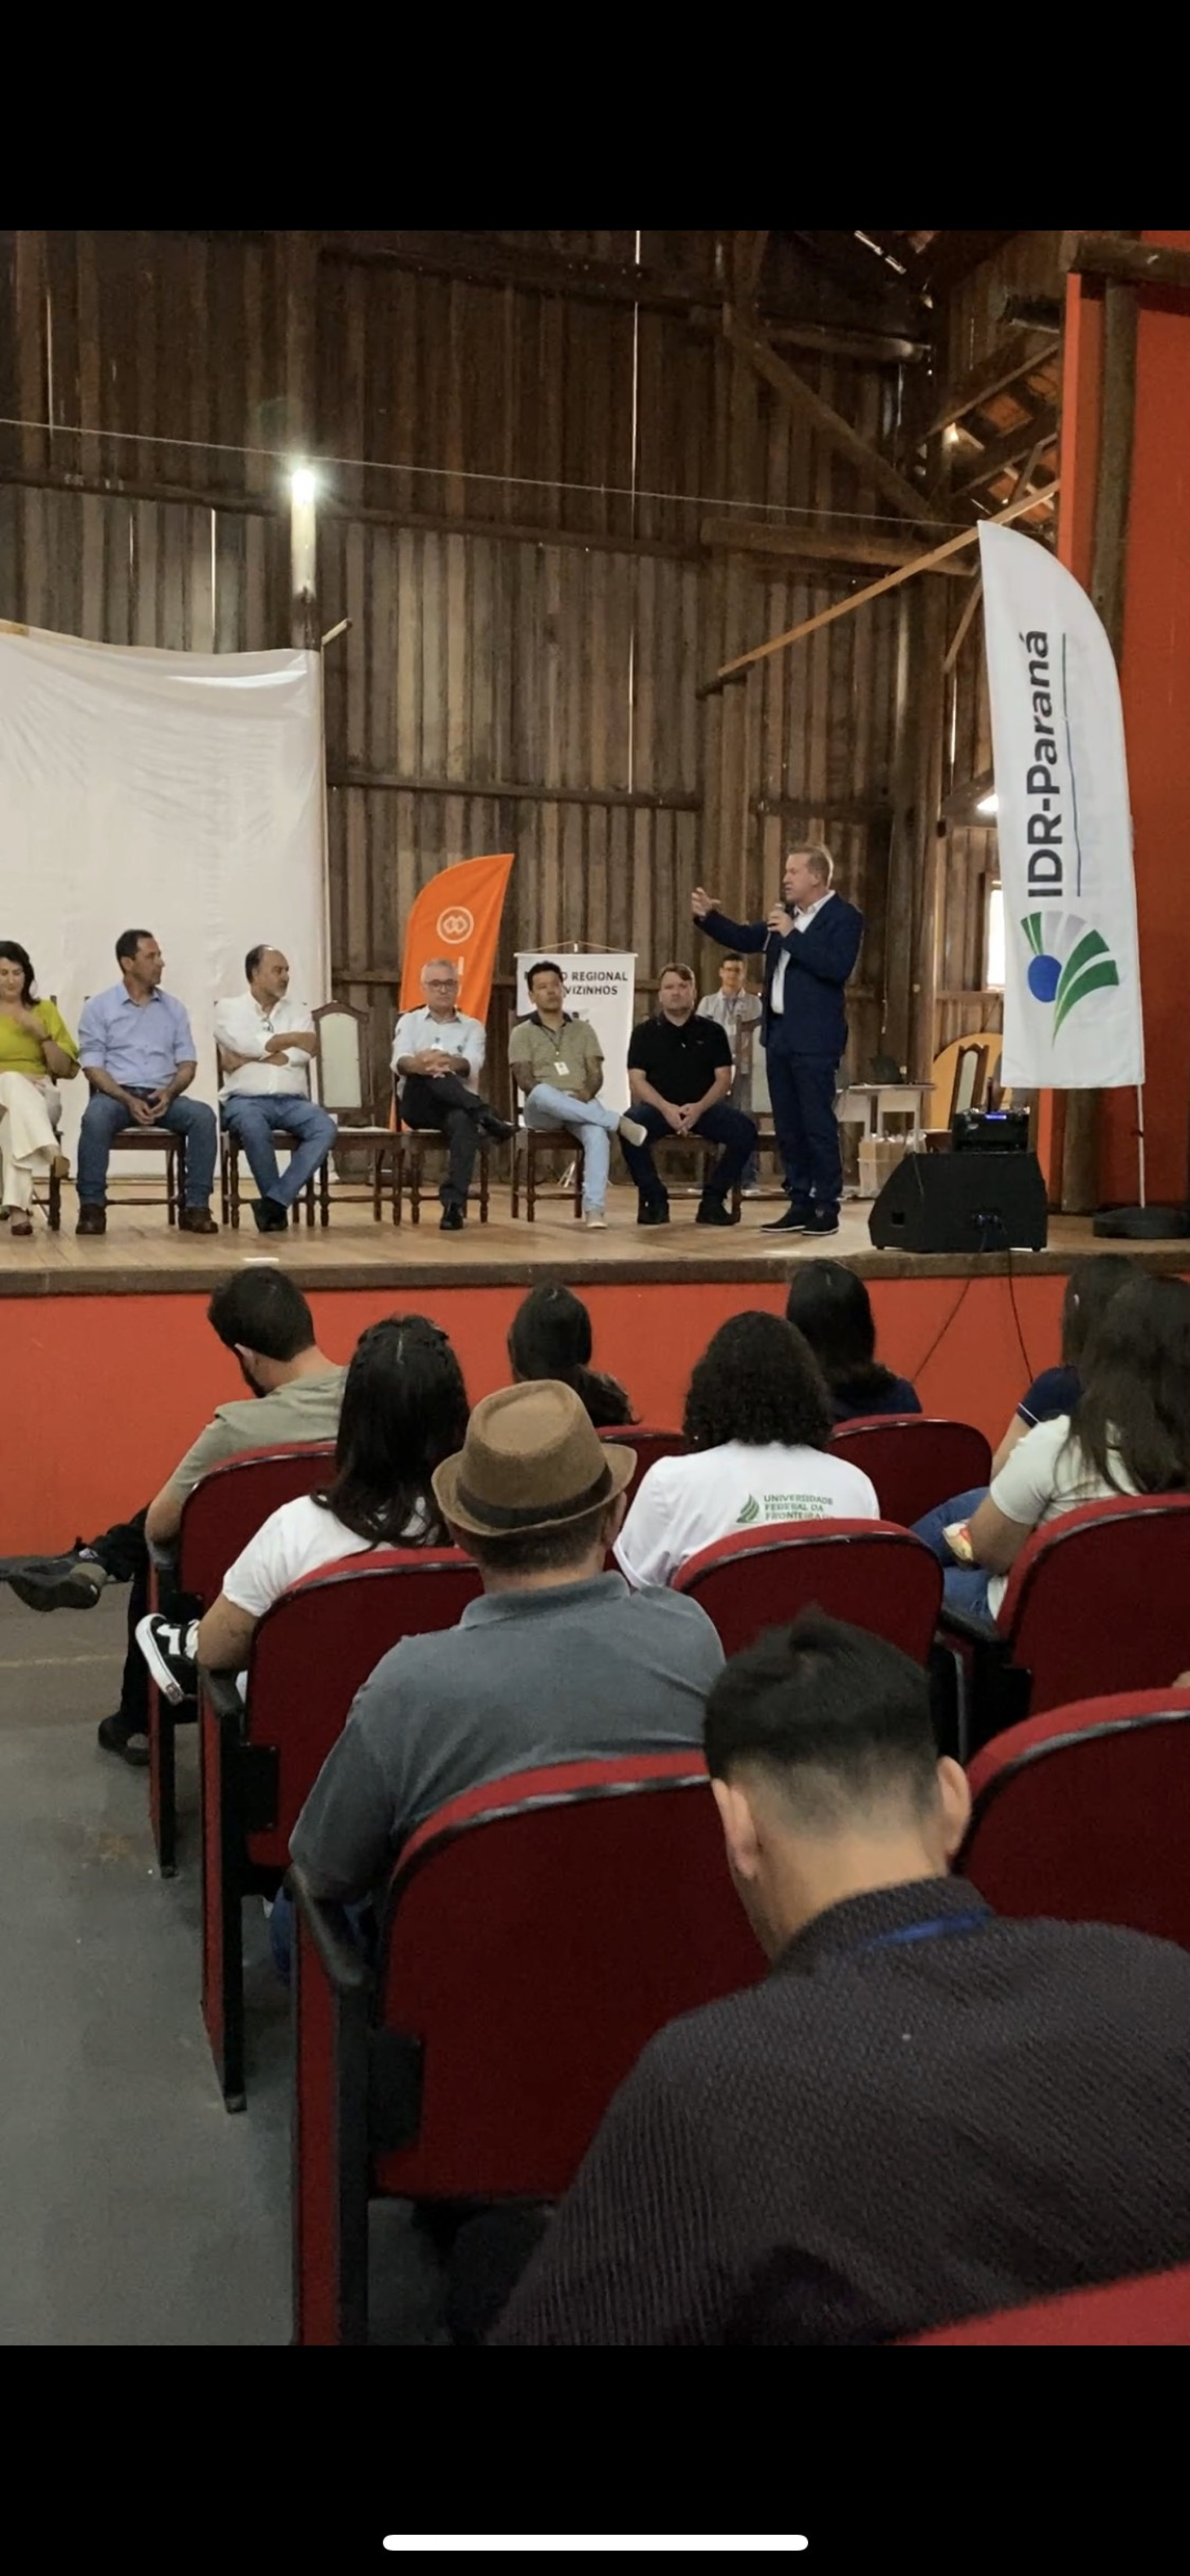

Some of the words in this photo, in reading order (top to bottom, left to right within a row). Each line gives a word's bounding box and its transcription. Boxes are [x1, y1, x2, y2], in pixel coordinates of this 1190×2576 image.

[1019, 629, 1063, 898] IDR-Paraná
[571, 971, 628, 981] REGIONAL
[565, 986, 618, 995] VIZINHOS
[764, 1494, 833, 1505] UNIVERSIDADE
